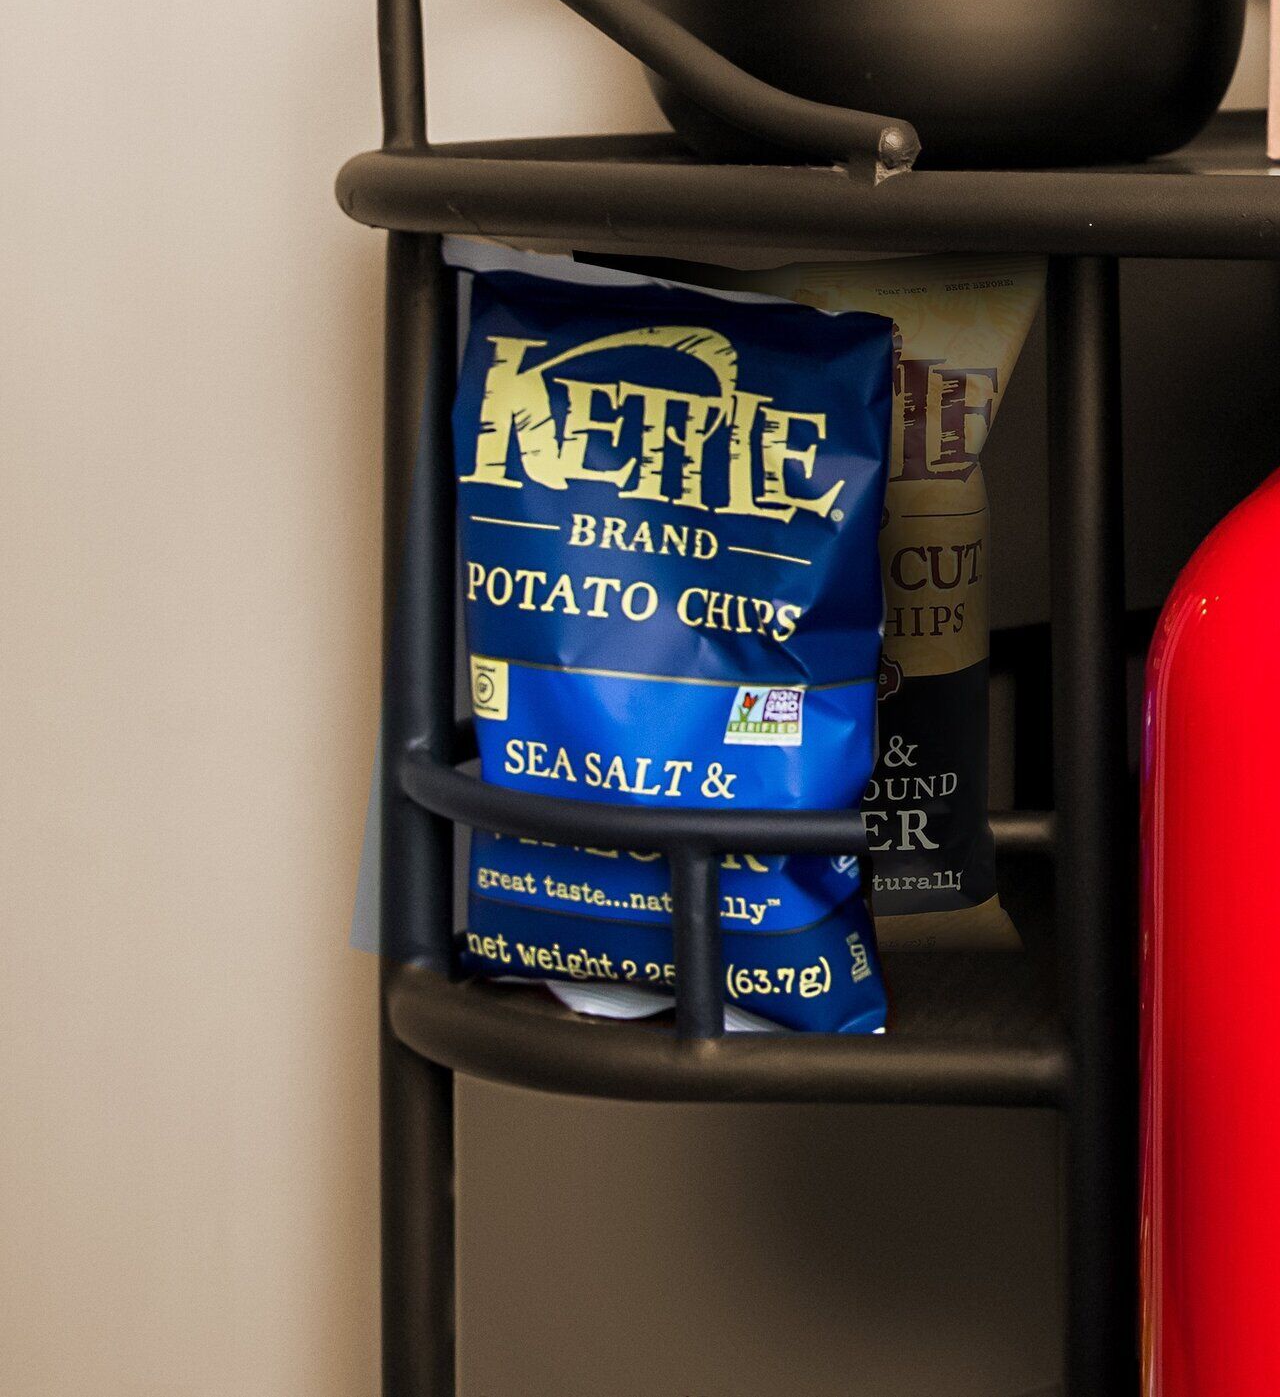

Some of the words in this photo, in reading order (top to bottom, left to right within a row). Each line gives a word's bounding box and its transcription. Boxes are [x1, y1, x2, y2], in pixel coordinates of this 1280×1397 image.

[459, 326, 845, 524] KETTLE
[569, 512, 719, 560] BRAND
[890, 539, 983, 592] CUT
[466, 561, 658, 621] POTATO
[676, 587, 803, 642] CHIPS
[885, 602, 965, 637] HIPS
[504, 738, 576, 782] SEA
[584, 753, 693, 798] SALT
[700, 762, 738, 799] &
[883, 735, 918, 768] &
[863, 772, 958, 802] OUND
[477, 866, 538, 894] great
[466, 932, 512, 965] net
[516, 943, 618, 980] weight
